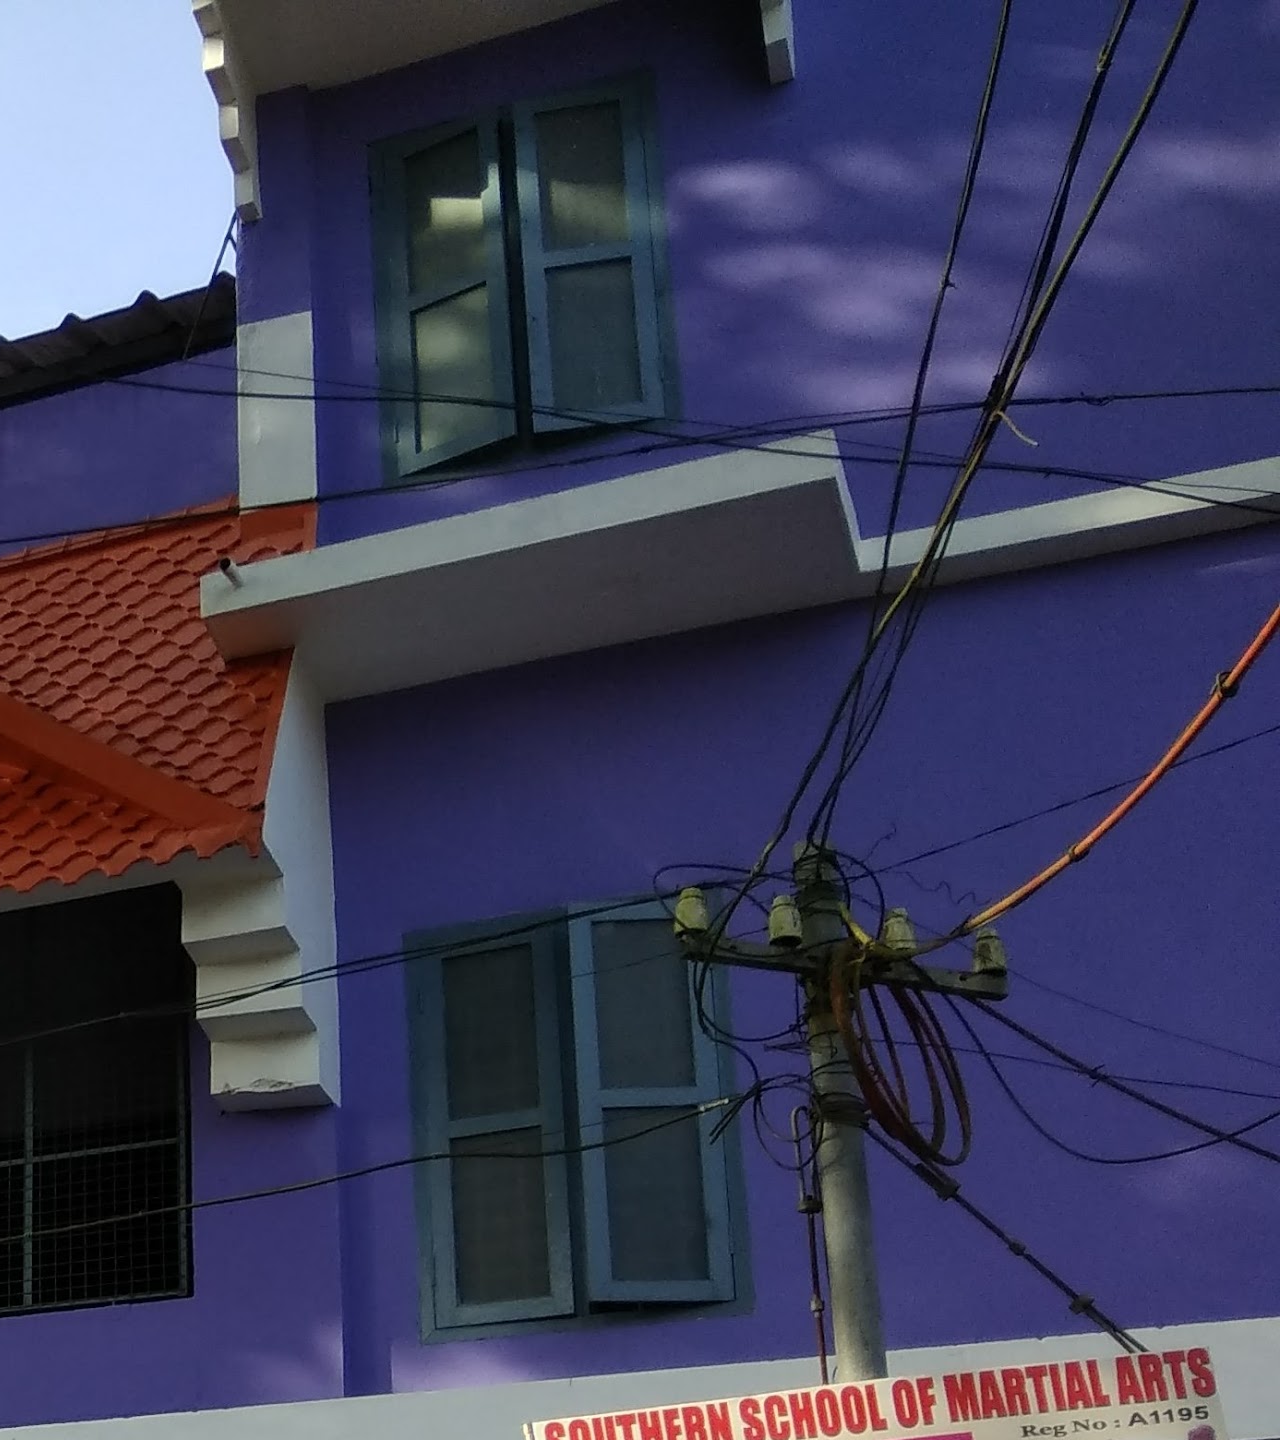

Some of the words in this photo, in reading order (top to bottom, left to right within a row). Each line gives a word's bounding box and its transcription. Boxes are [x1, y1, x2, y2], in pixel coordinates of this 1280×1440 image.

[891, 1377, 938, 1429] OF
[942, 1358, 1112, 1423] MARTIAL
[1115, 1348, 1217, 1405] ARTS
[1021, 1423, 1068, 1439] Reg
[1072, 1418, 1107, 1433] No
[1128, 1405, 1209, 1428] A1195
